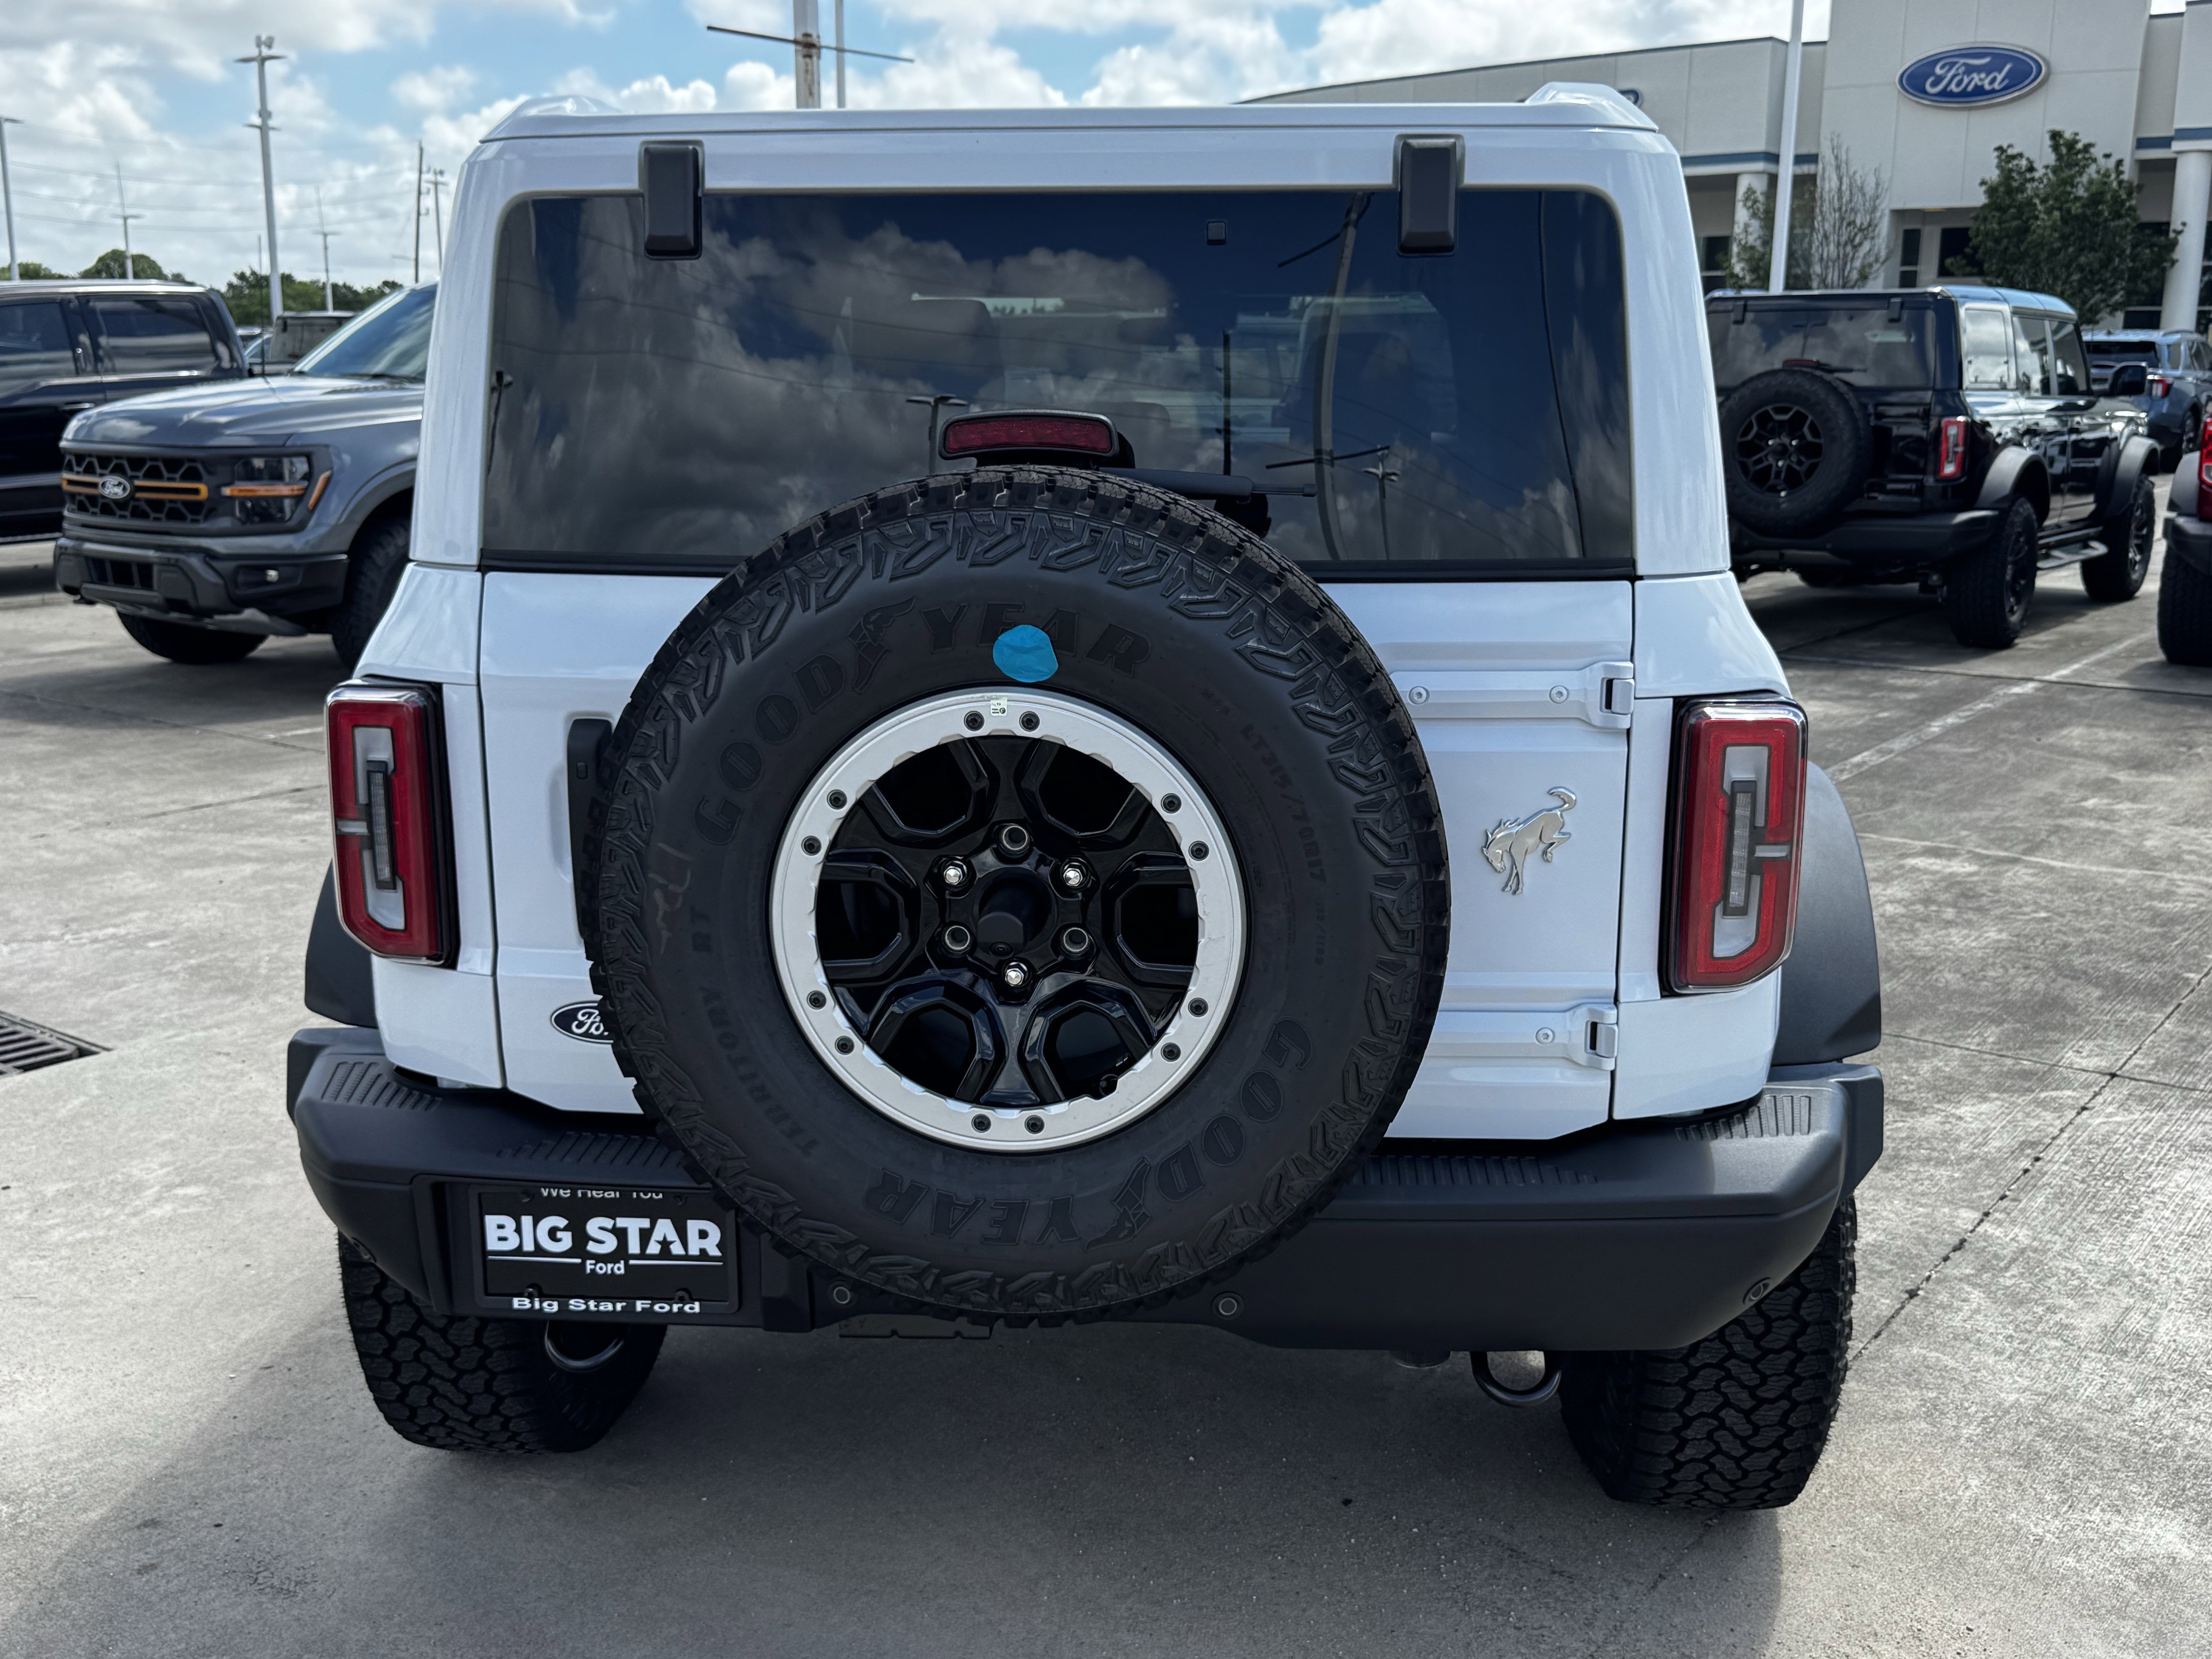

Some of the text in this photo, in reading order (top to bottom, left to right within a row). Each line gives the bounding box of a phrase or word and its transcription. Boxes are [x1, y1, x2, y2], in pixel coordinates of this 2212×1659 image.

[1925, 56, 2013, 94] Ford
[571, 1008, 609, 1035] Fo
[689, 905, 820, 1157] TERRITORY RT
[484, 1215, 722, 1256] BIG STAR
[586, 1260, 625, 1274] Ford
[512, 1297, 700, 1313] Big Star Ford
